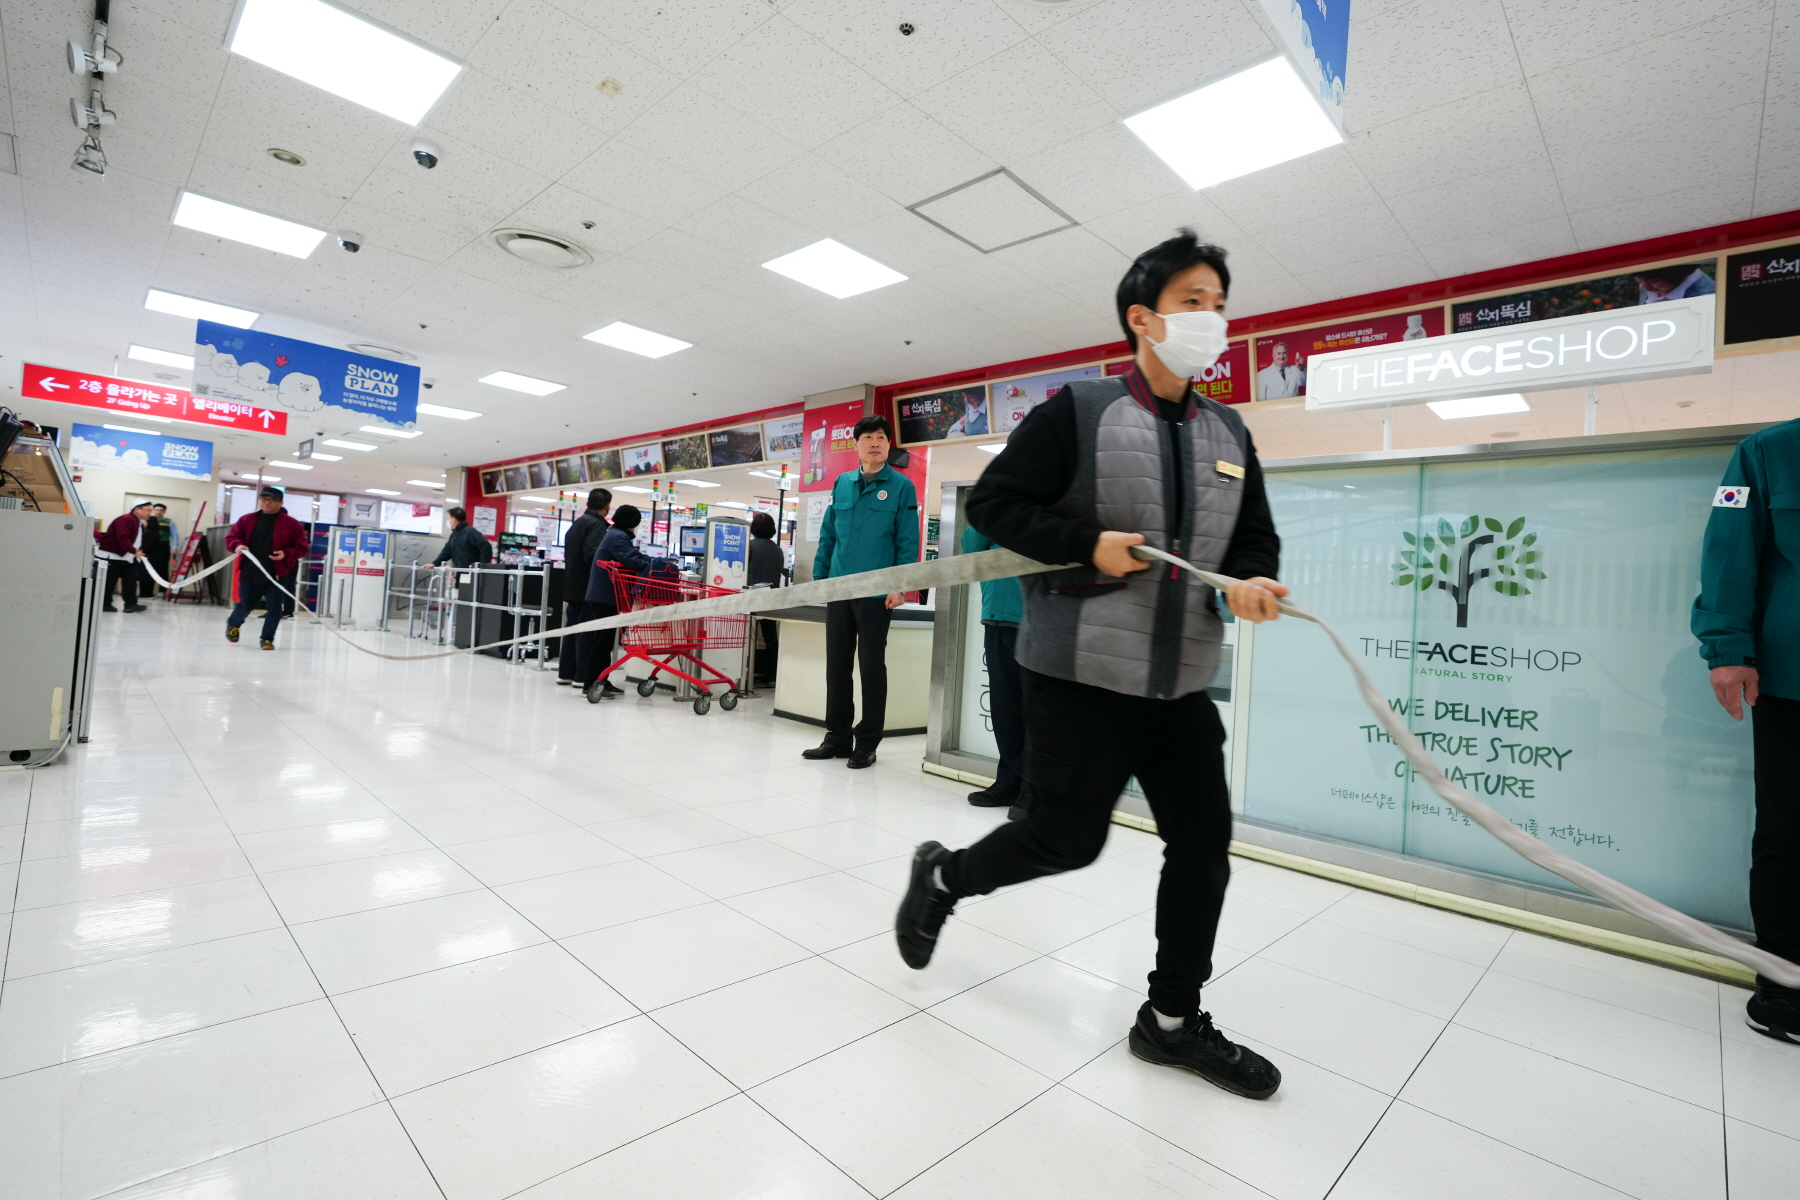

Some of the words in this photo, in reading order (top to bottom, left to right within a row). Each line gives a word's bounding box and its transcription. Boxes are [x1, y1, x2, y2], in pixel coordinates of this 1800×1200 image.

[1330, 319, 1677, 393] THEFACESHOP
[347, 364, 398, 383] SNOW
[349, 378, 394, 395] PLAN
[79, 379, 103, 394] 2층
[106, 383, 161, 402] 올라가는
[163, 393, 178, 406] 곳
[1210, 380, 1233, 395] 된다
[192, 397, 253, 418] 엘리베이터
[1359, 637, 1582, 672] THEFACESHOP
[1471, 672, 1514, 683] STORY
[1388, 698, 1425, 717] WE
[1434, 700, 1539, 732] DELIVER
[1359, 724, 1398, 746] TH
[1414, 731, 1479, 757] TRUE
[1486, 737, 1573, 772] STORY
[1331, 787, 1395, 810] 더페이스샵은
[1548, 823, 1620, 852] 전합니다.
